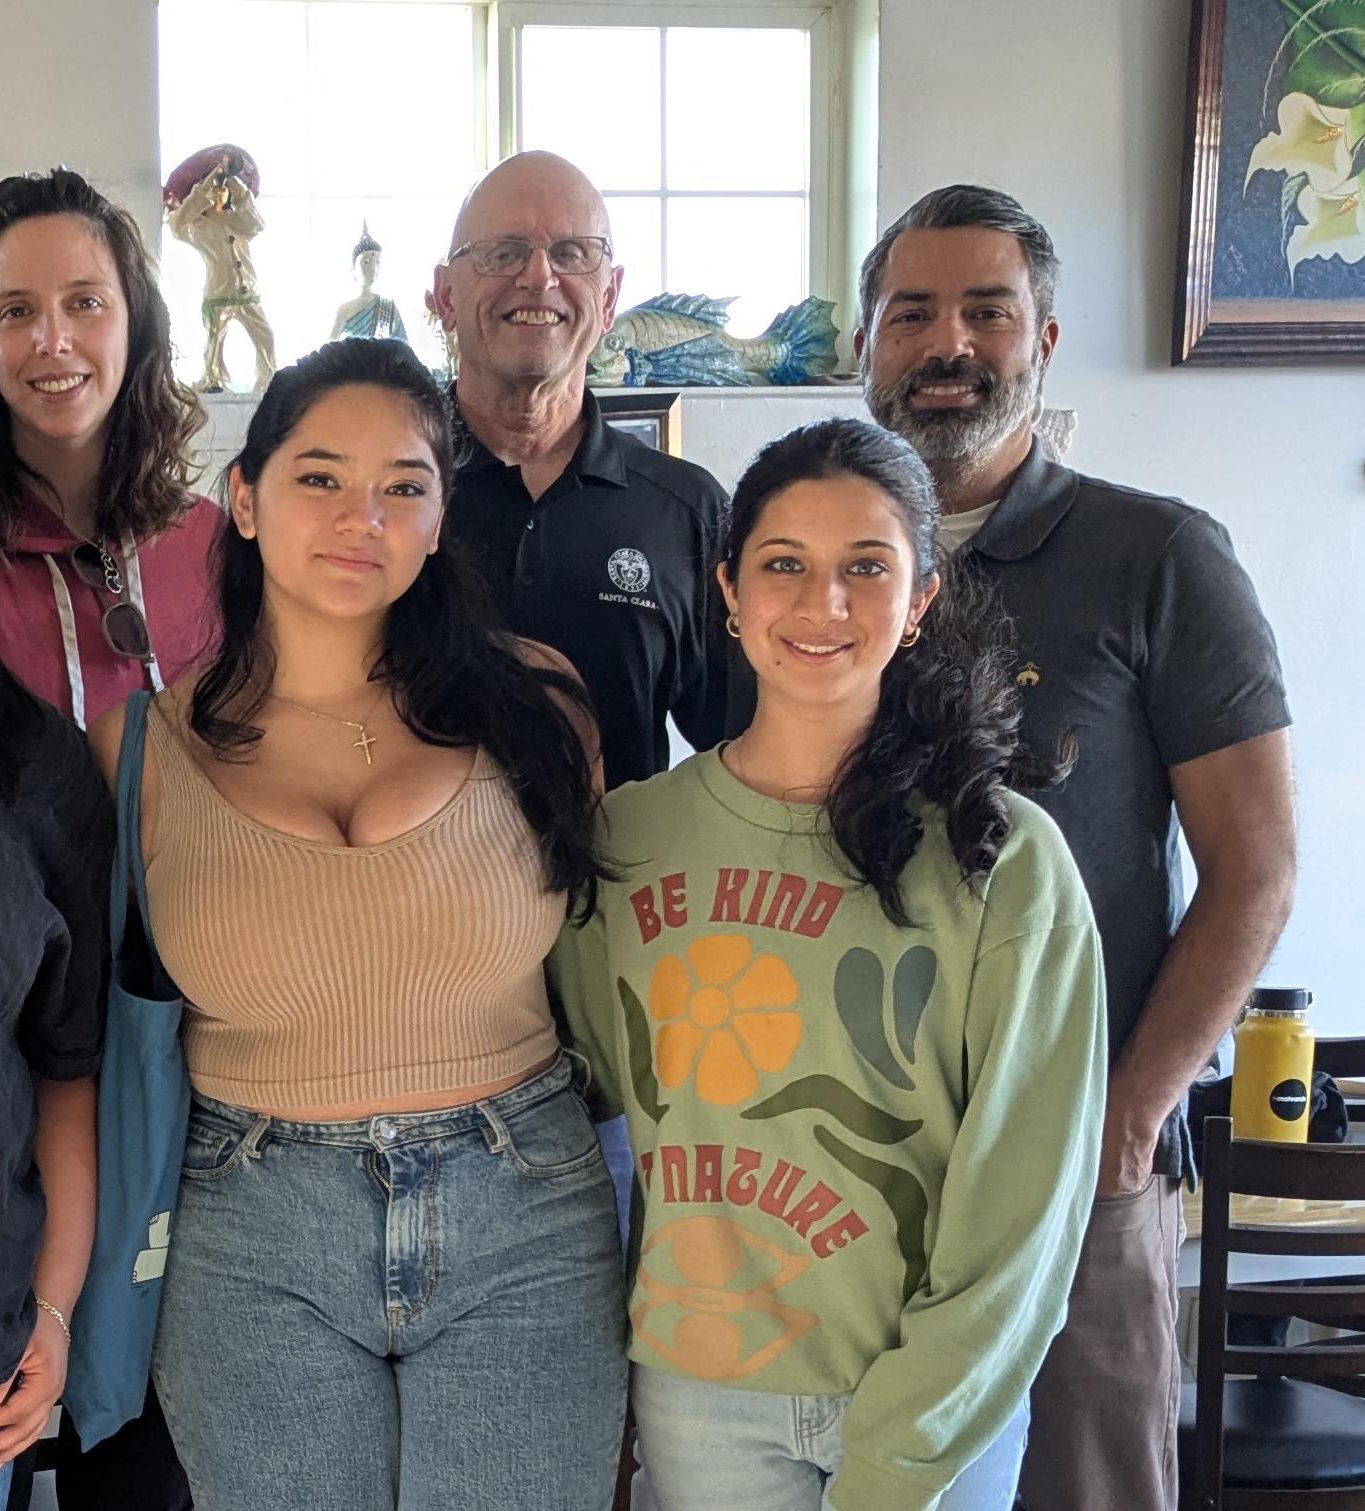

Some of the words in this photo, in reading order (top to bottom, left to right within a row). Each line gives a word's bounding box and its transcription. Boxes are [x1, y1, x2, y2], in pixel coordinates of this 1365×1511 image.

[598, 592, 628, 603] SANTA
[630, 597, 656, 609] CLARA
[628, 872, 688, 945] BE
[707, 867, 845, 939] KIND
[659, 1144, 870, 1259] NATURE
